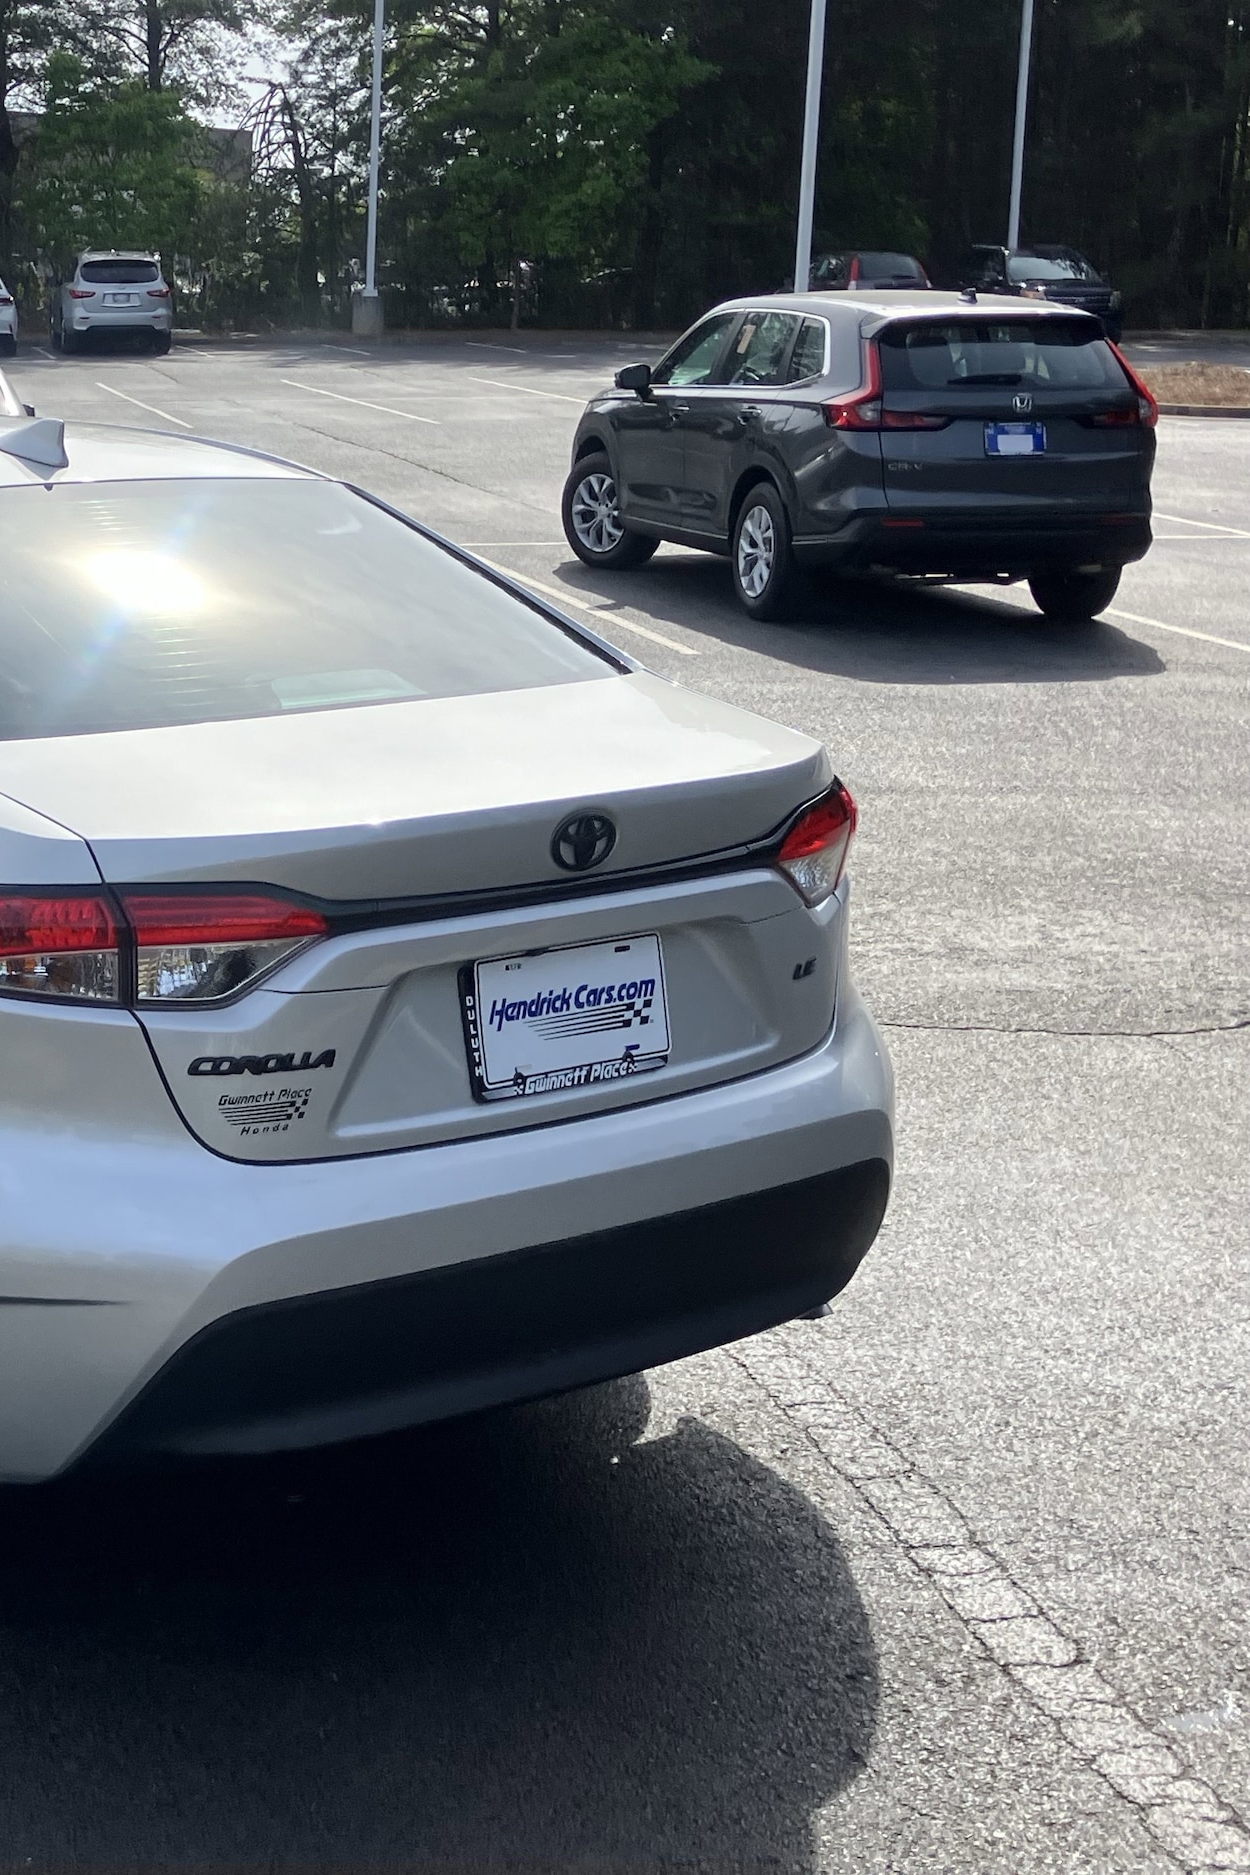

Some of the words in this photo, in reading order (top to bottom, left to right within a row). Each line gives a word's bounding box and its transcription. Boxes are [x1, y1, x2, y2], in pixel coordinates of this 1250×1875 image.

[465, 995, 484, 1077] DULUTH
[188, 1049, 337, 1076] COROLLA
[524, 1065, 591, 1095] Gwinnett
[590, 1060, 629, 1083] Place
[218, 1090, 275, 1106] Gwinnett
[278, 1088, 312, 1101] Place
[240, 1123, 289, 1136] Honda
